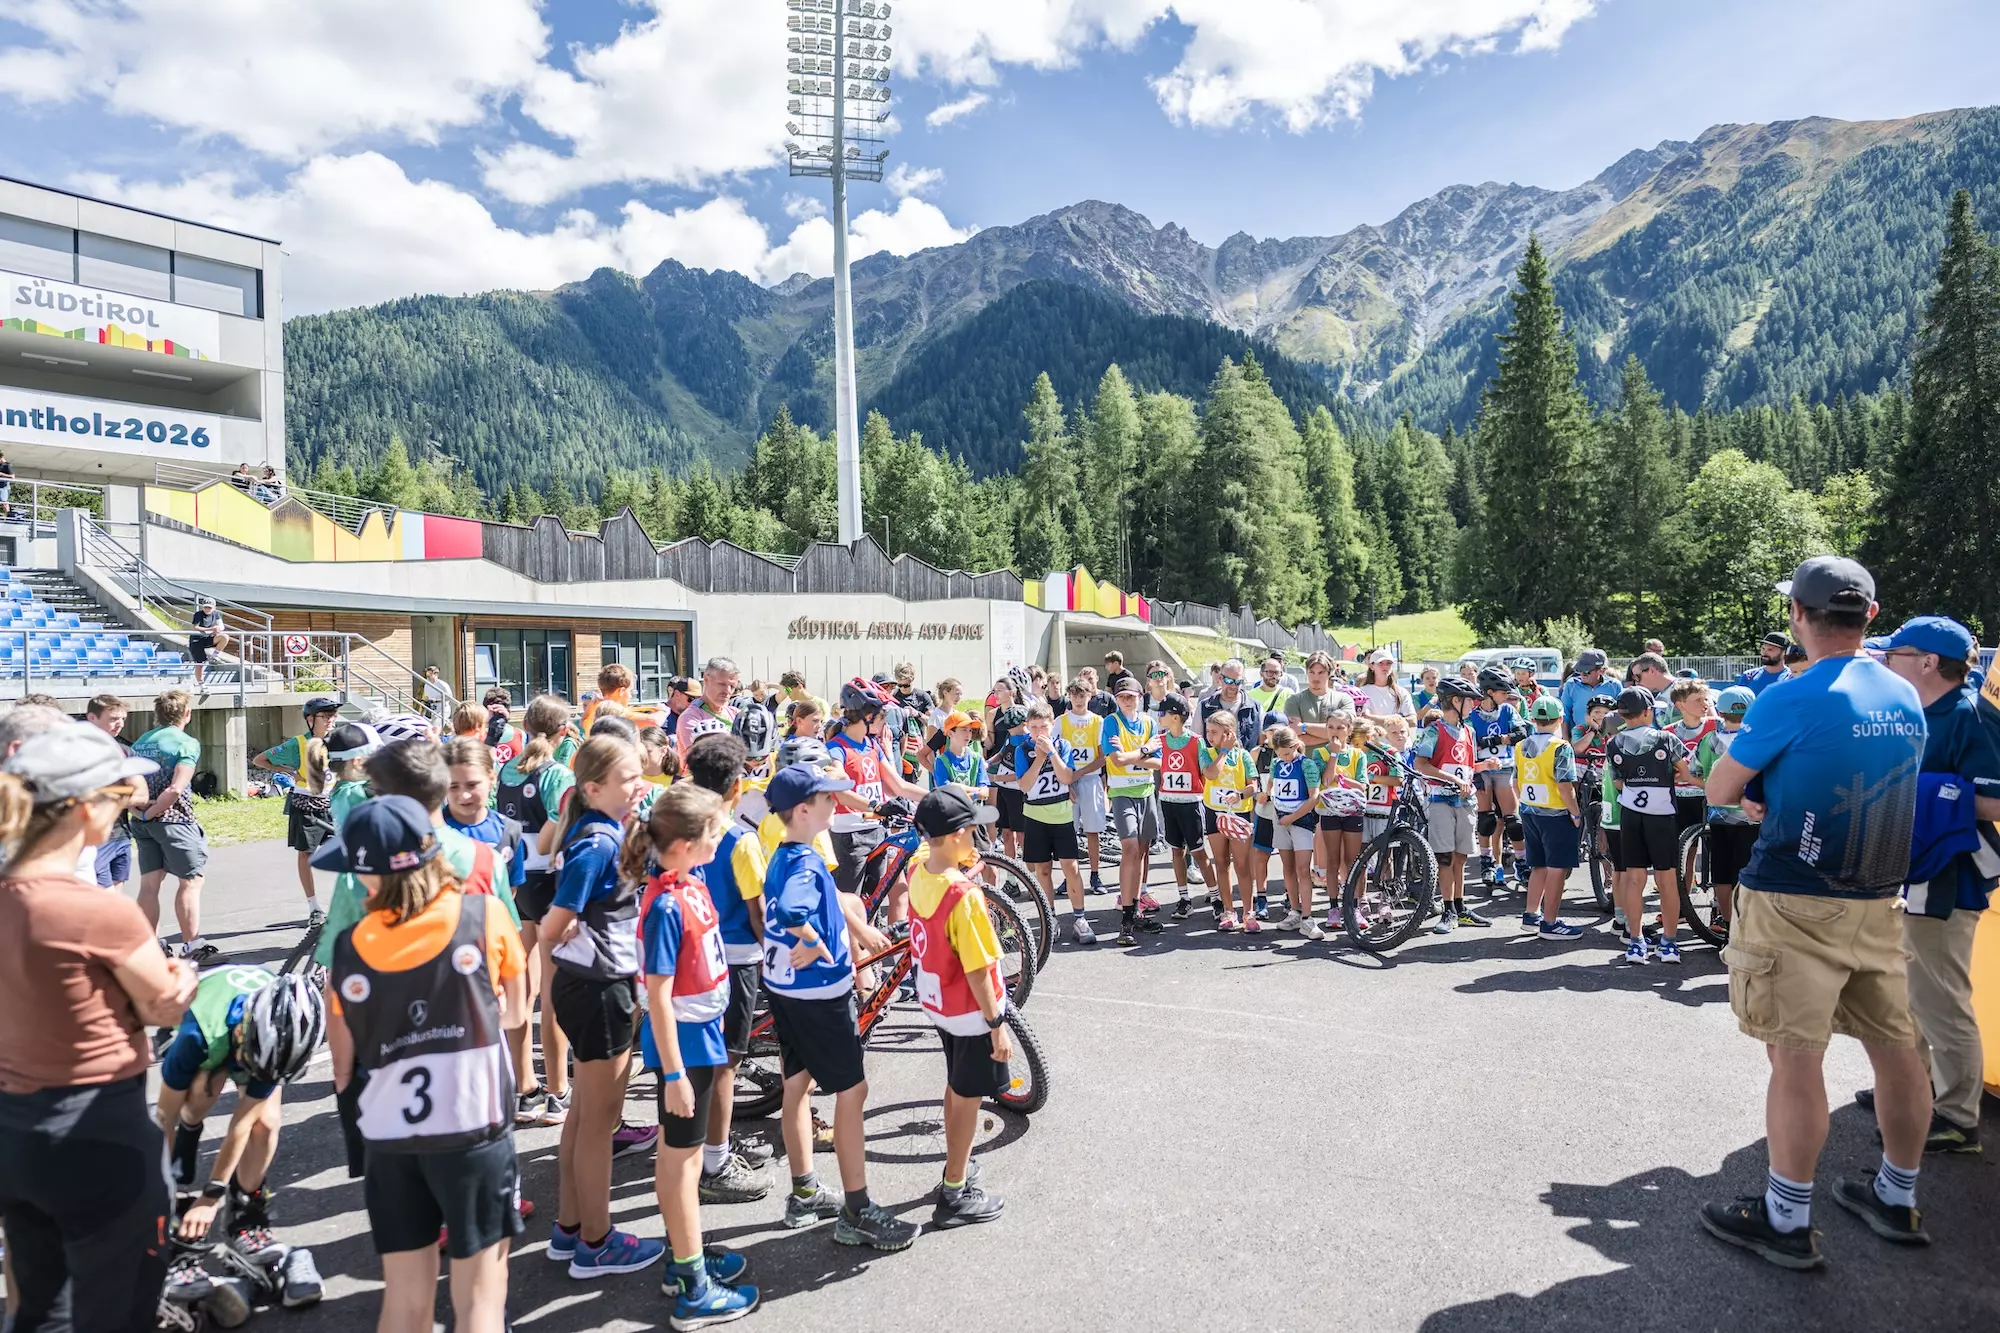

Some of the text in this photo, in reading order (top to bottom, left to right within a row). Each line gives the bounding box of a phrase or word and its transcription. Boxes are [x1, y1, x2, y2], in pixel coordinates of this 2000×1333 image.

[0, 406, 210, 448] ntholz2026
[788, 616, 985, 640] SÜDTIROL ARENA ALTO ADIGE
[1868, 709, 1906, 722] TEAM
[1852, 720, 1922, 738] SÜDTIROL
[1071, 748, 1088, 761] 24
[1038, 774, 1061, 795] 25
[1167, 774, 1185, 789] 14
[1278, 782, 1292, 797] 14
[1526, 785, 1536, 801] 8
[1632, 790, 1649, 808] 8
[1797, 810, 1815, 861] ENERGIA
[1806, 836, 1822, 868] PURA
[785, 967, 792, 979] 4
[400, 1065, 433, 1125] 3
